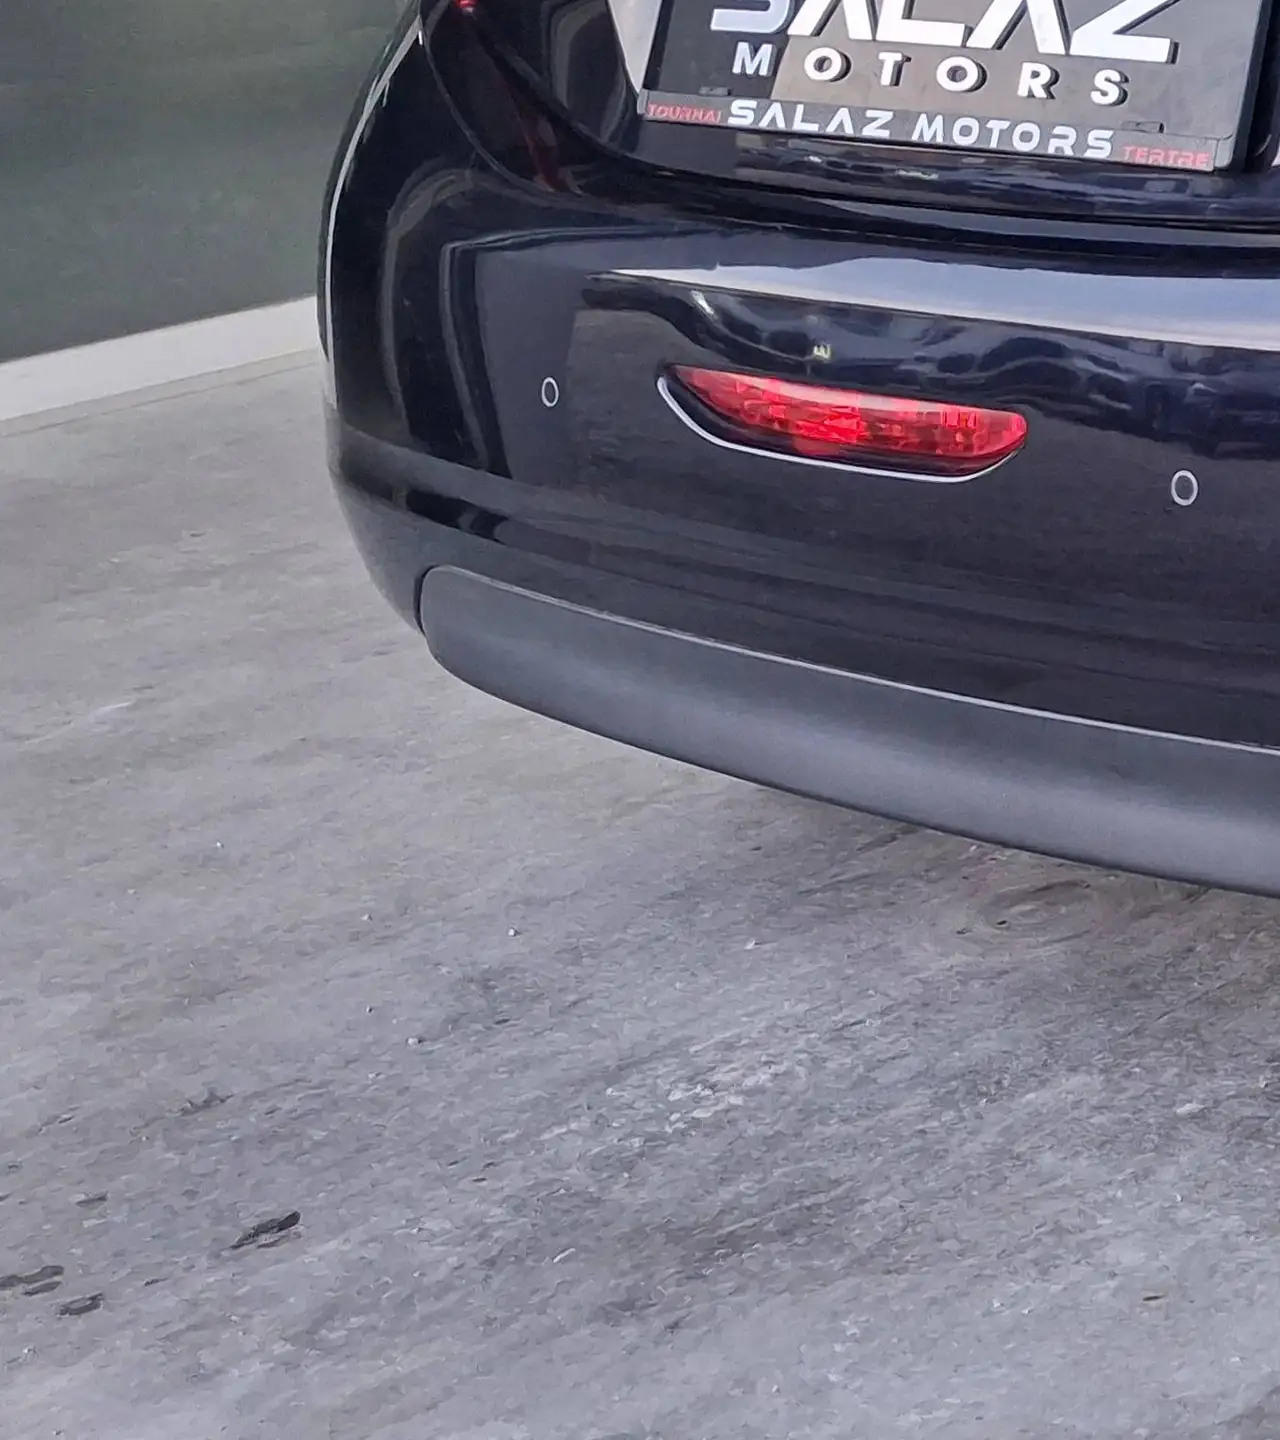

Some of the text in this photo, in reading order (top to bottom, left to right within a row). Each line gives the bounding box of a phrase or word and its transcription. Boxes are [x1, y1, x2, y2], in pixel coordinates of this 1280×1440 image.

[732, 41, 1128, 106] MOTORS
[648, 99, 1210, 169] TOURNAI SALAZ MOTORS TERTRE
